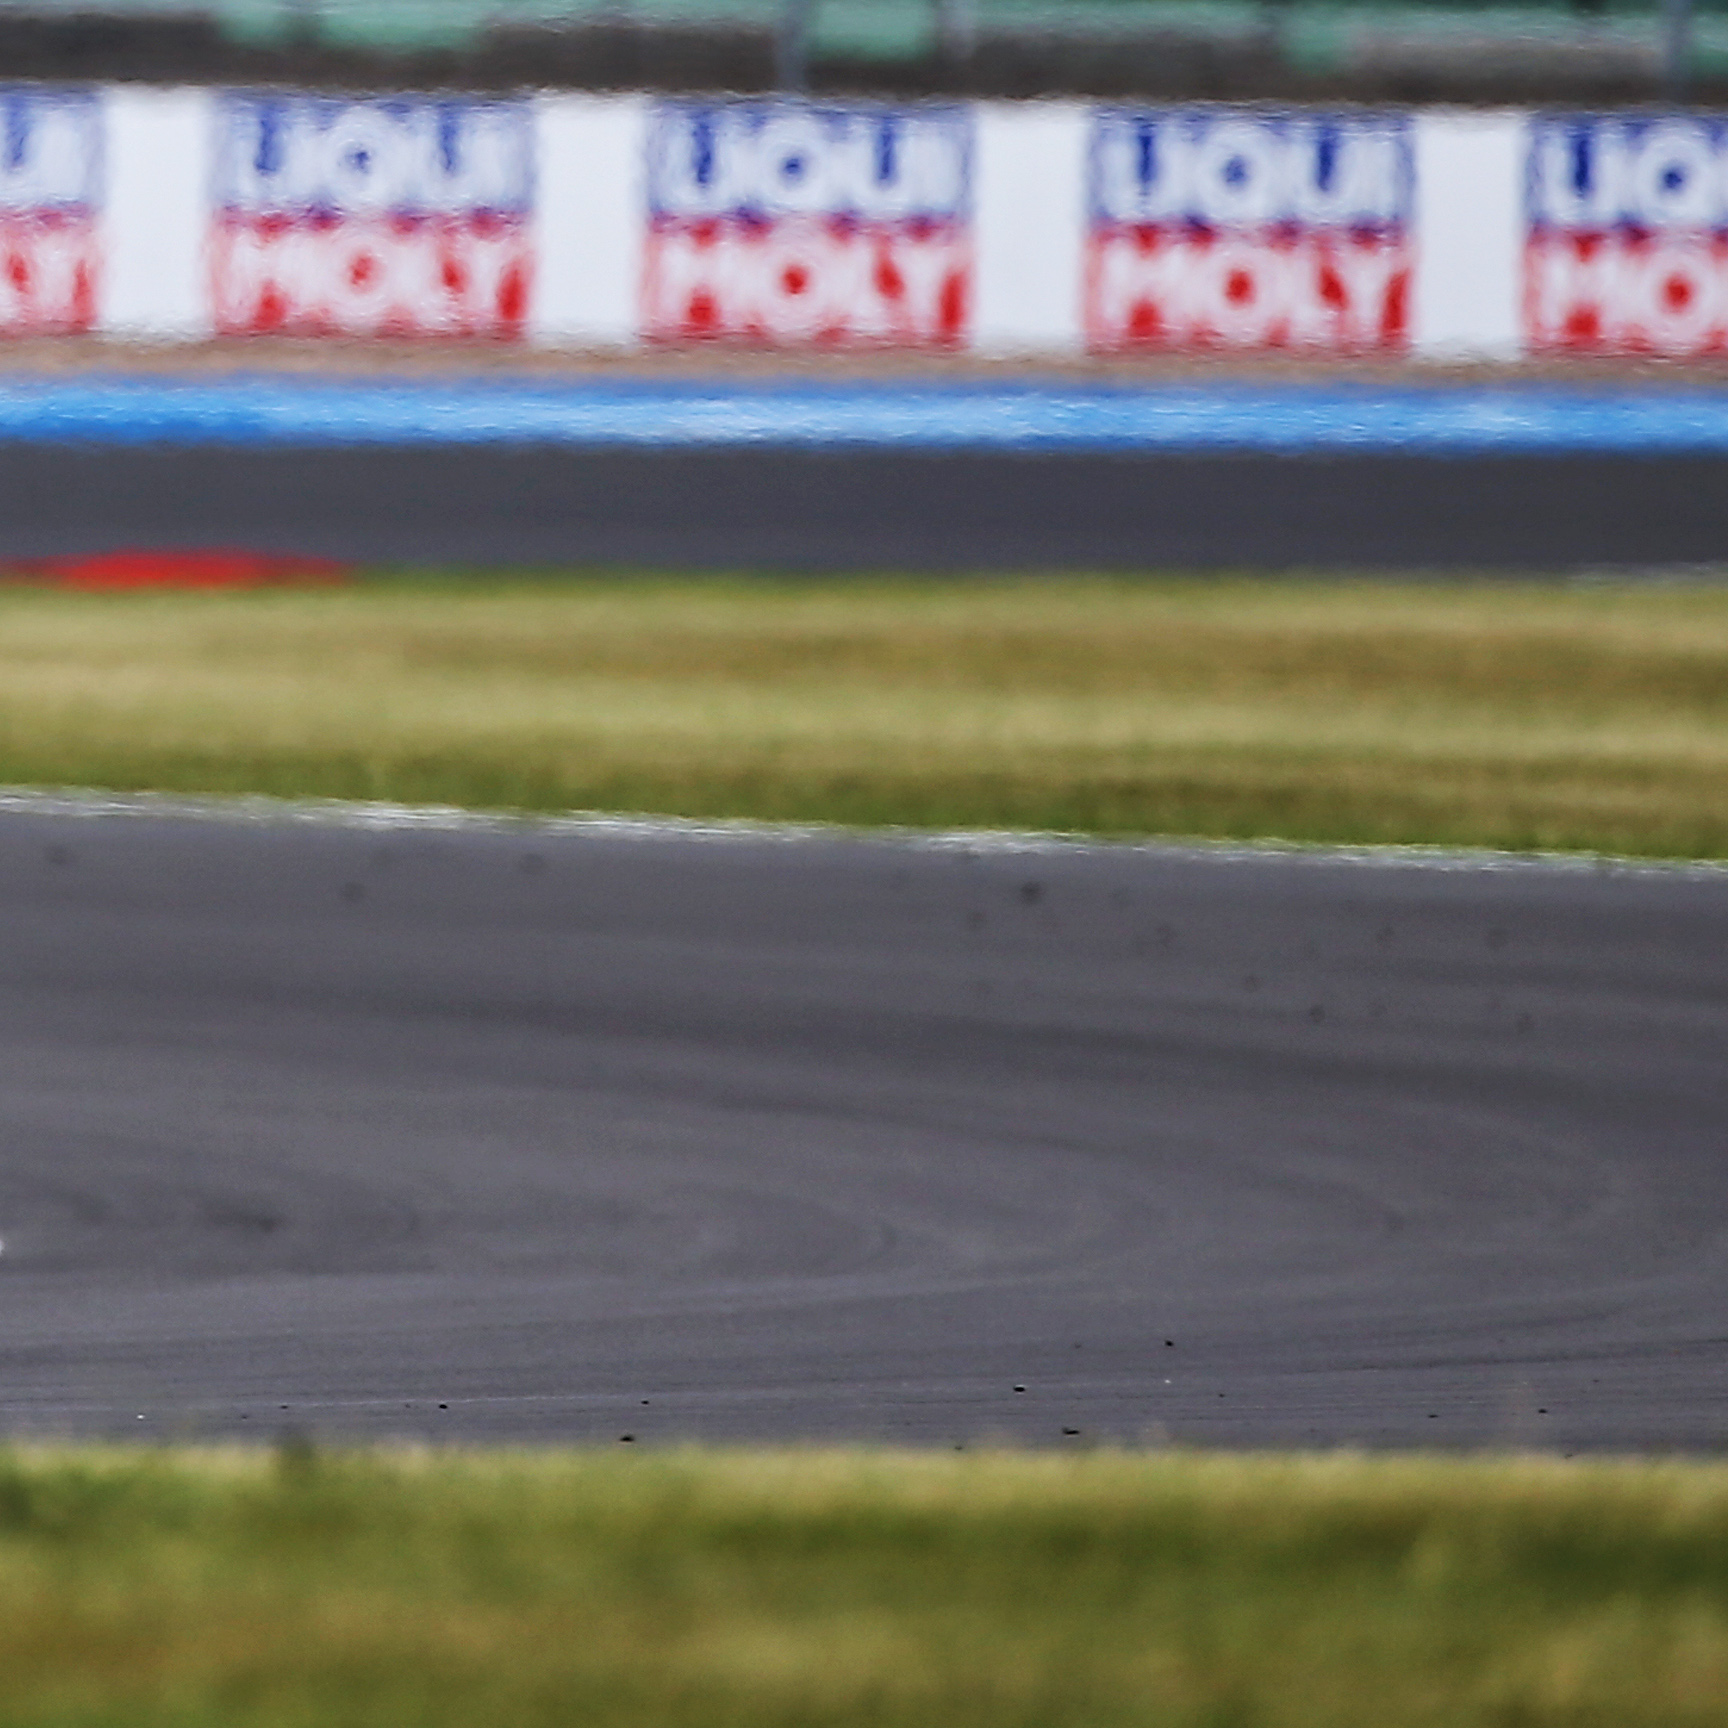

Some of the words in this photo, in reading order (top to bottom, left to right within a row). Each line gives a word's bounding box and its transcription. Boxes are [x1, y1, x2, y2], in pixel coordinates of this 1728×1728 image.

[220, 218, 530, 325] MOLY
[655, 221, 965, 330] MOLY
[1095, 229, 1410, 340] MOLY
